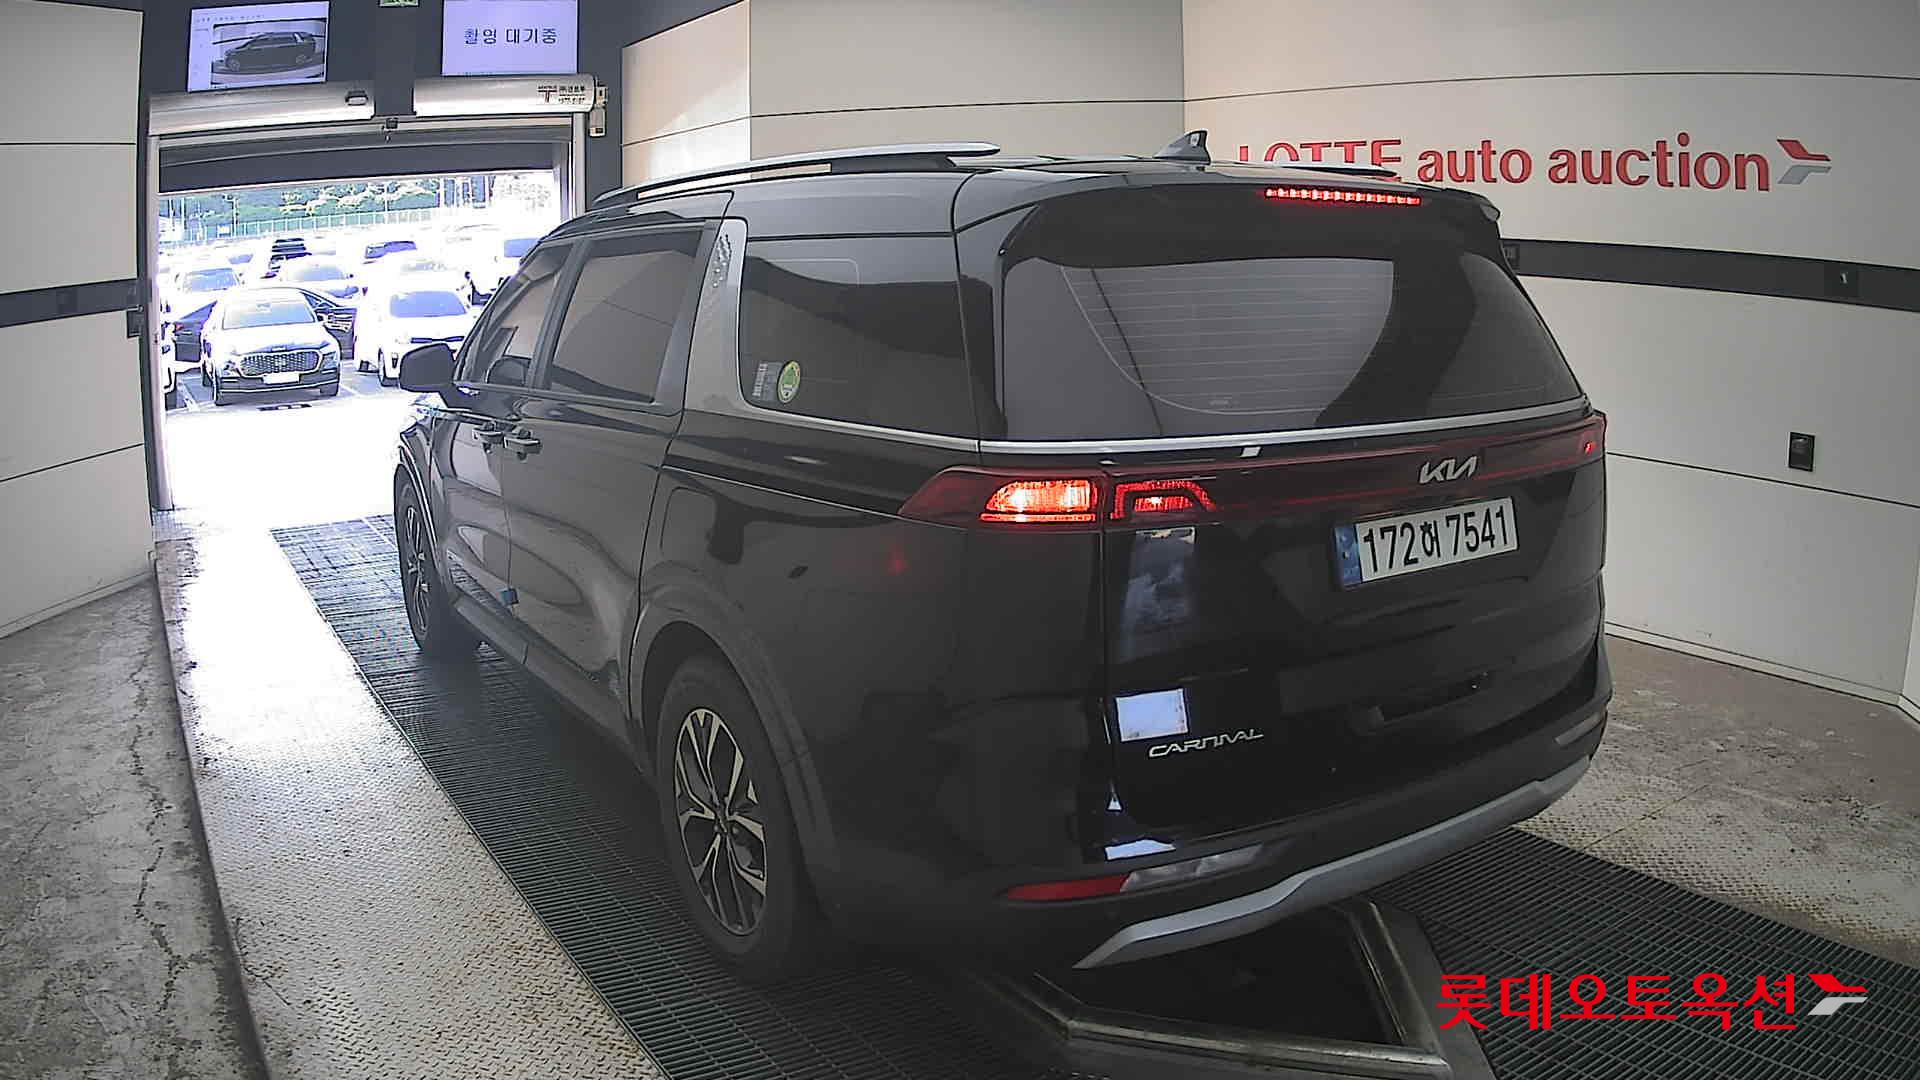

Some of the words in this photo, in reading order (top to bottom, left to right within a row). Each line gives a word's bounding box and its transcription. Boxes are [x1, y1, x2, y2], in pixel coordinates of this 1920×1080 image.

[505, 28, 557, 45] 대기중
[1417, 140, 1532, 183] auto
[1549, 132, 1769, 191] auction
[1419, 455, 1478, 484] KIA
[1445, 505, 1508, 556] 7541
[1149, 729, 1264, 758] CARNIVAL
